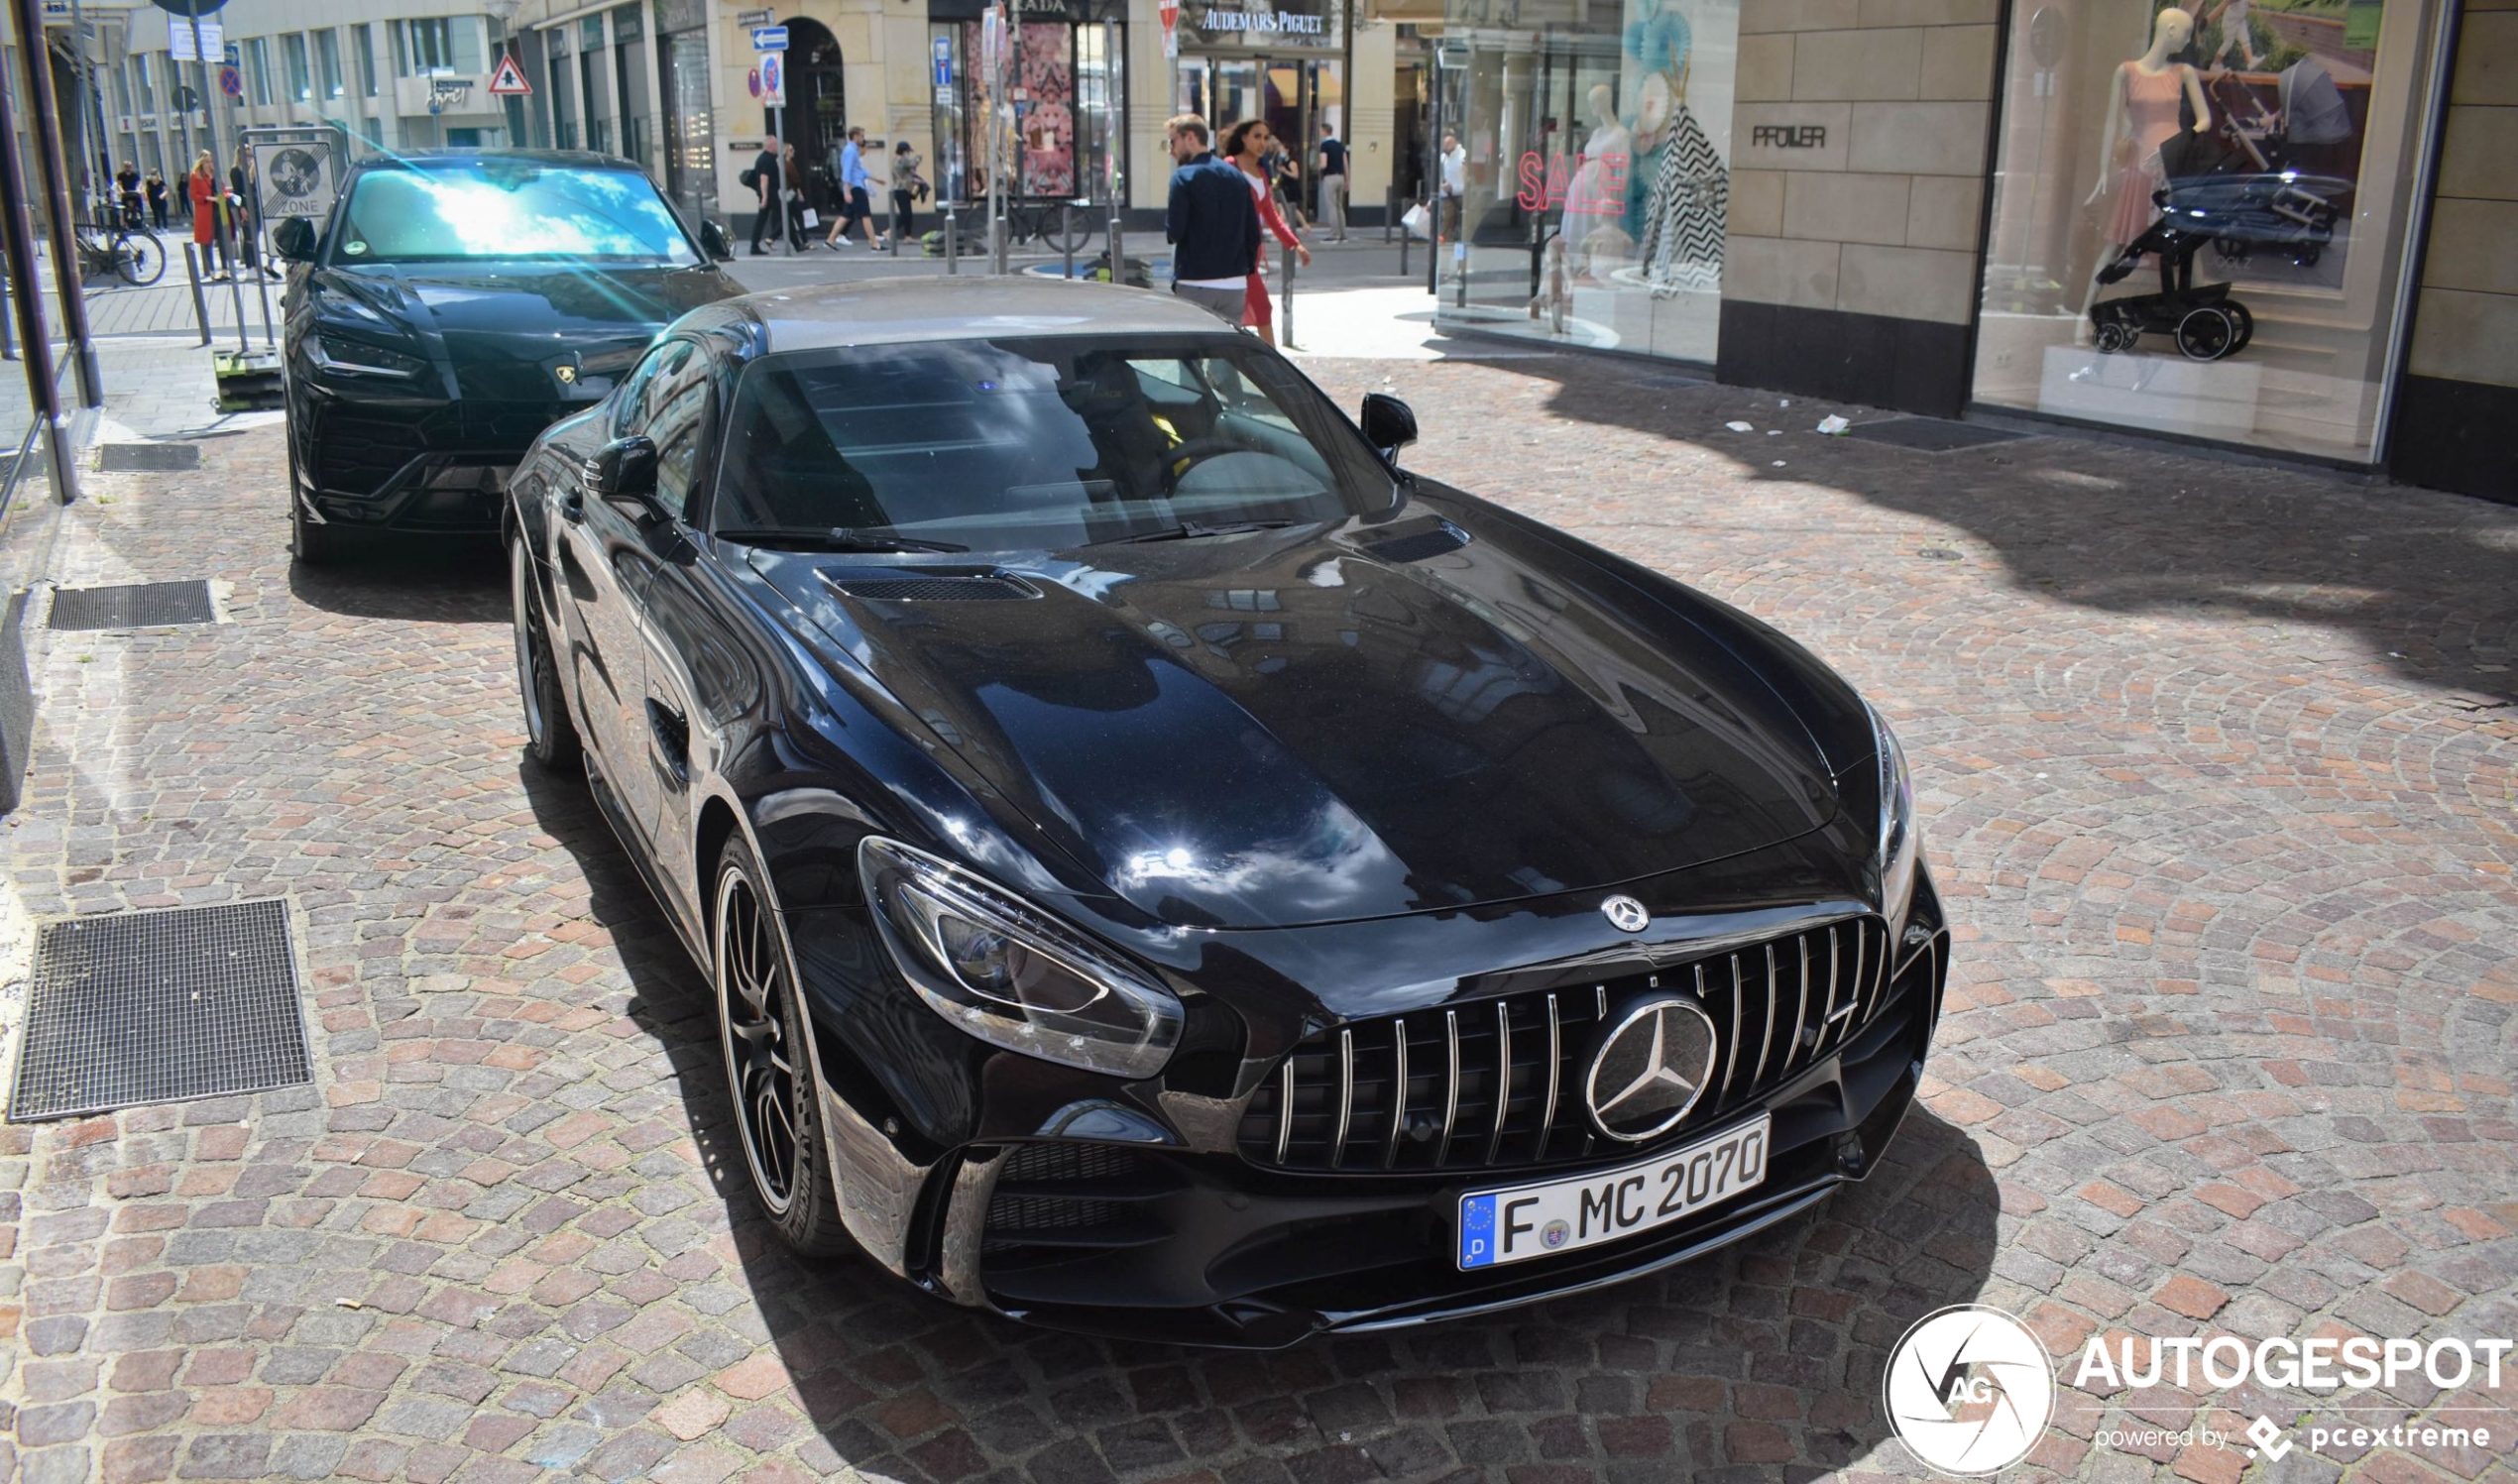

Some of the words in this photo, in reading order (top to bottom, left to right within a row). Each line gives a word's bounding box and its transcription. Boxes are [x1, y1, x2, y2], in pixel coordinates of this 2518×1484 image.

[1202, 8, 1276, 32] AUDEMARS
[1277, 11, 1322, 34] PIGUET
[1517, 151, 1629, 215] SALE
[282, 200, 318, 214] ZONE
[1503, 1196, 1540, 1254] F
[1578, 1175, 1646, 1239] MC
[1657, 1130, 1763, 1218] 2070
[1471, 1239, 1484, 1255] D
